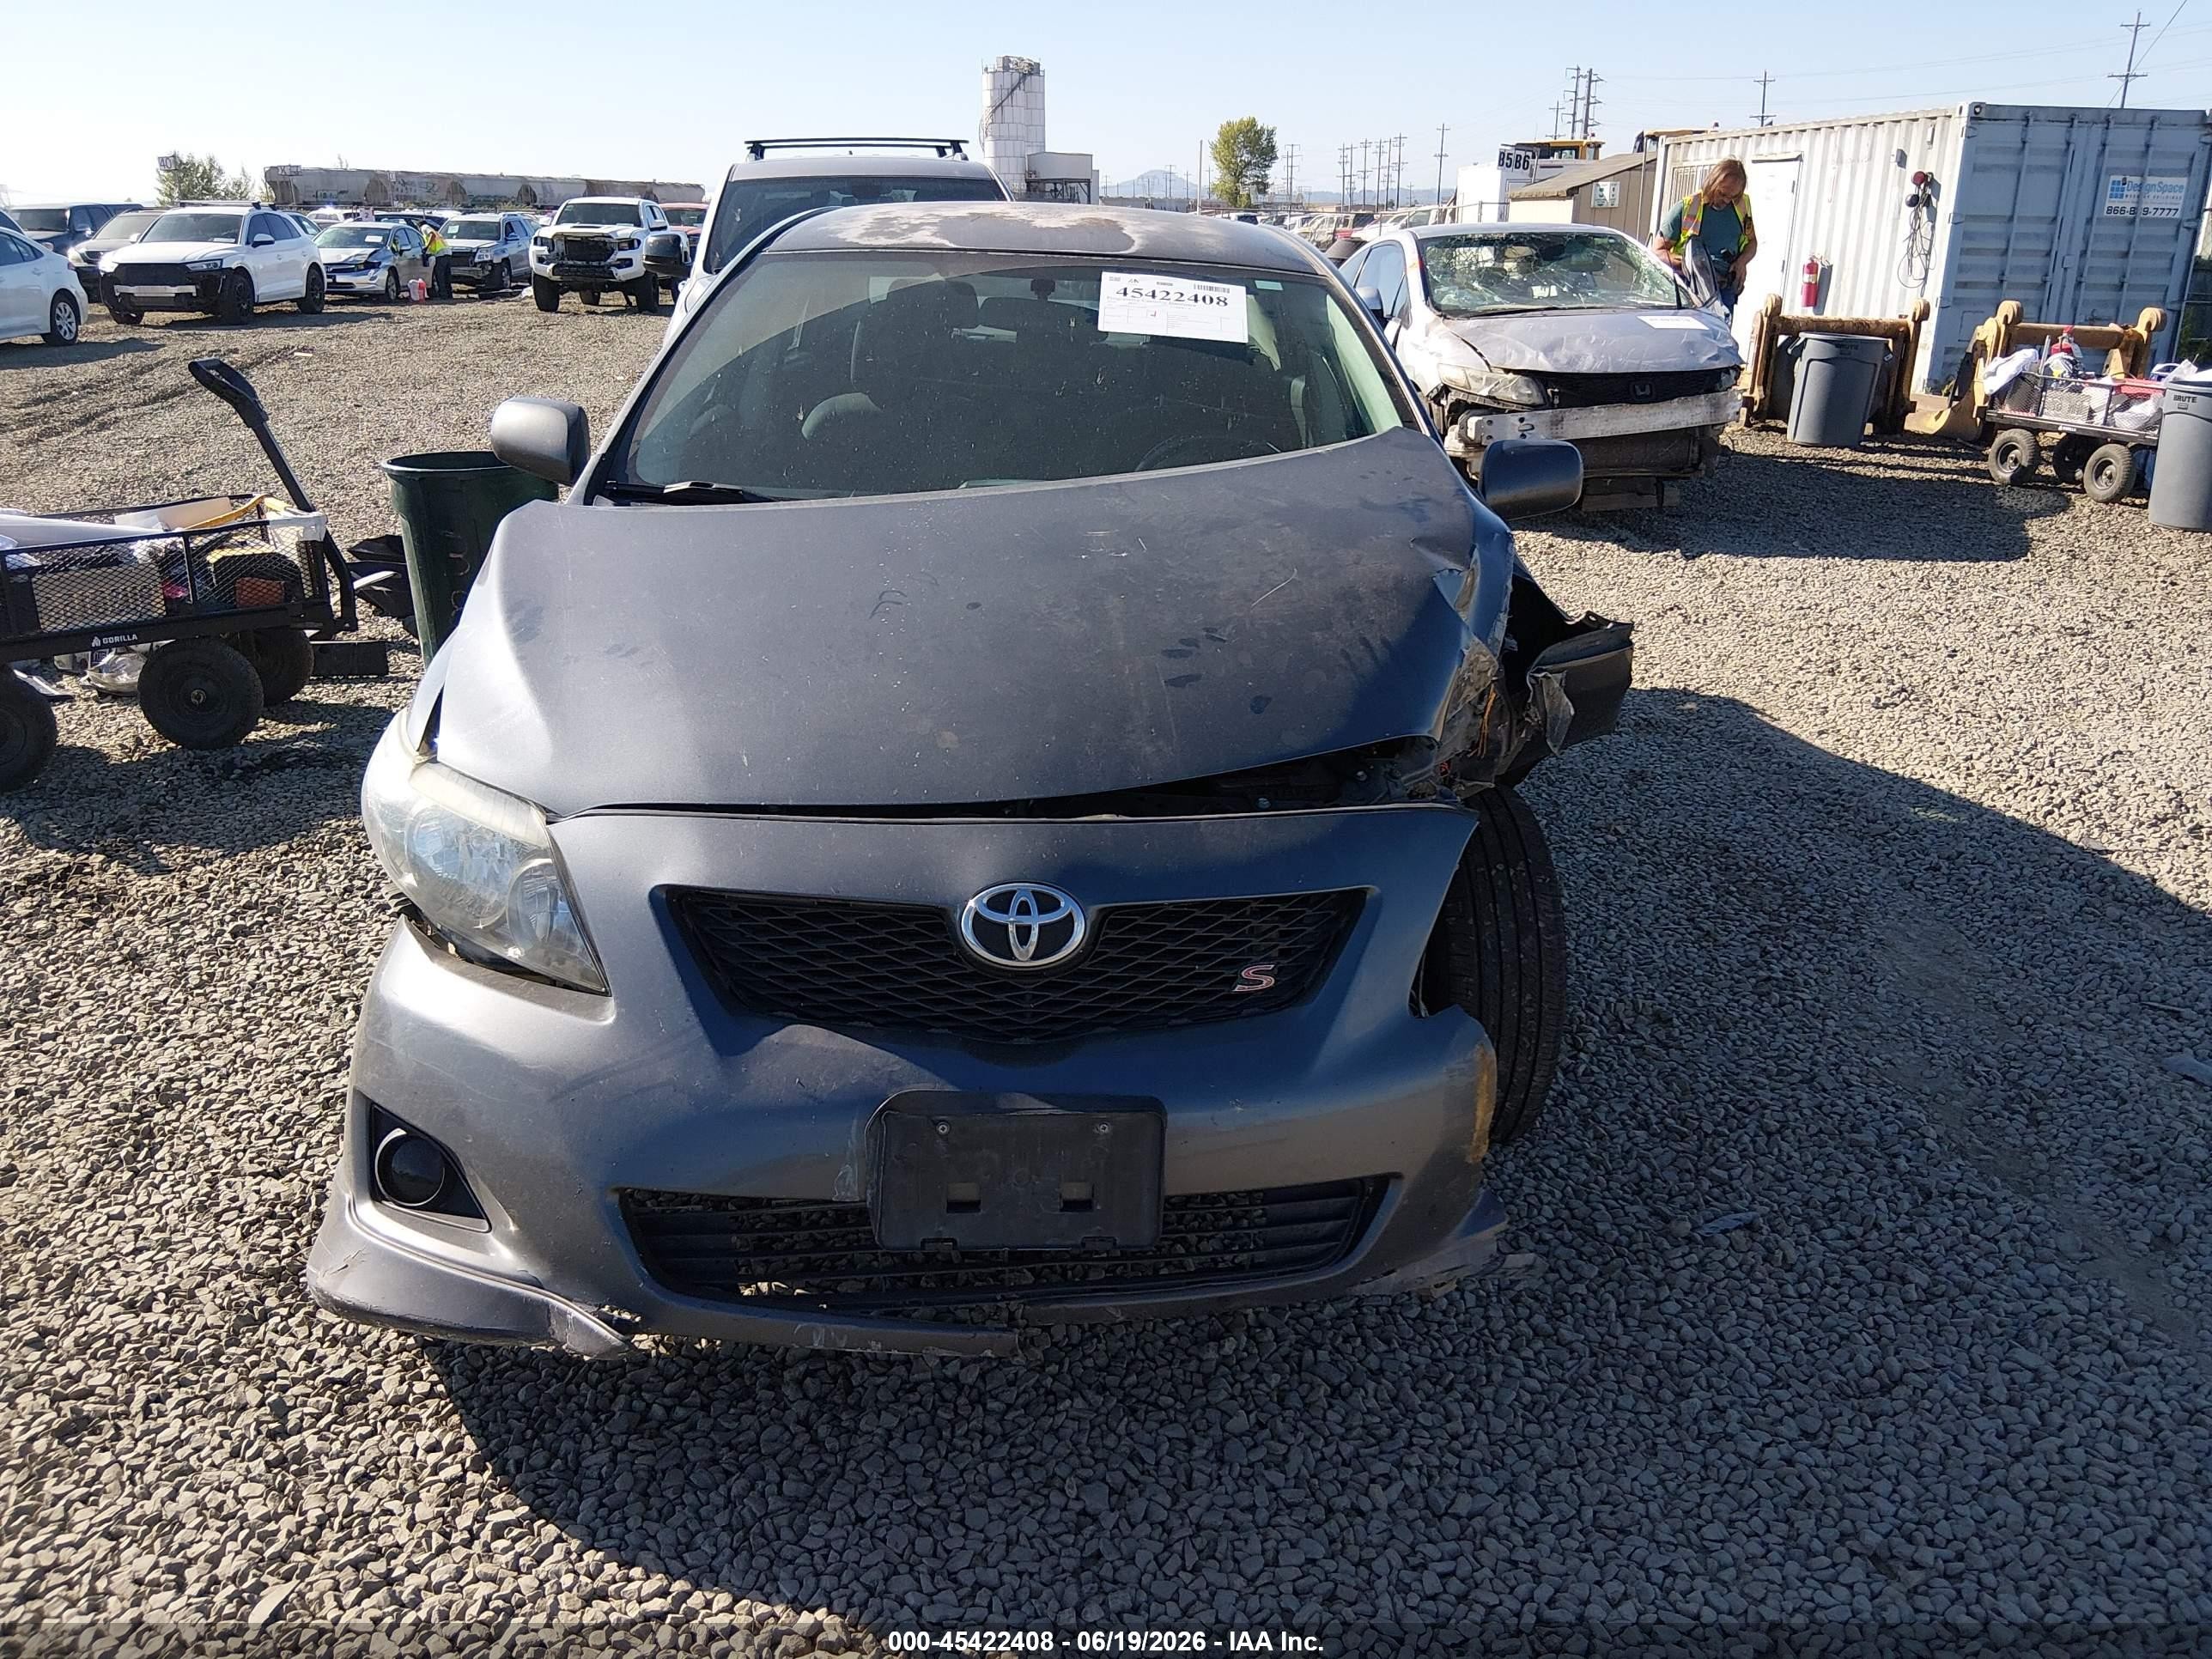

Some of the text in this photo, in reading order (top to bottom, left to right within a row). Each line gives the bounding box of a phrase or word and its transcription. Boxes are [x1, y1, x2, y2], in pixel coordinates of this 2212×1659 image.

[2106, 205, 2179, 216] 866-89-7777
[1116, 287, 1229, 307] 45422408
[102, 634, 137, 644] GORILLA
[1233, 964, 1275, 992] S
